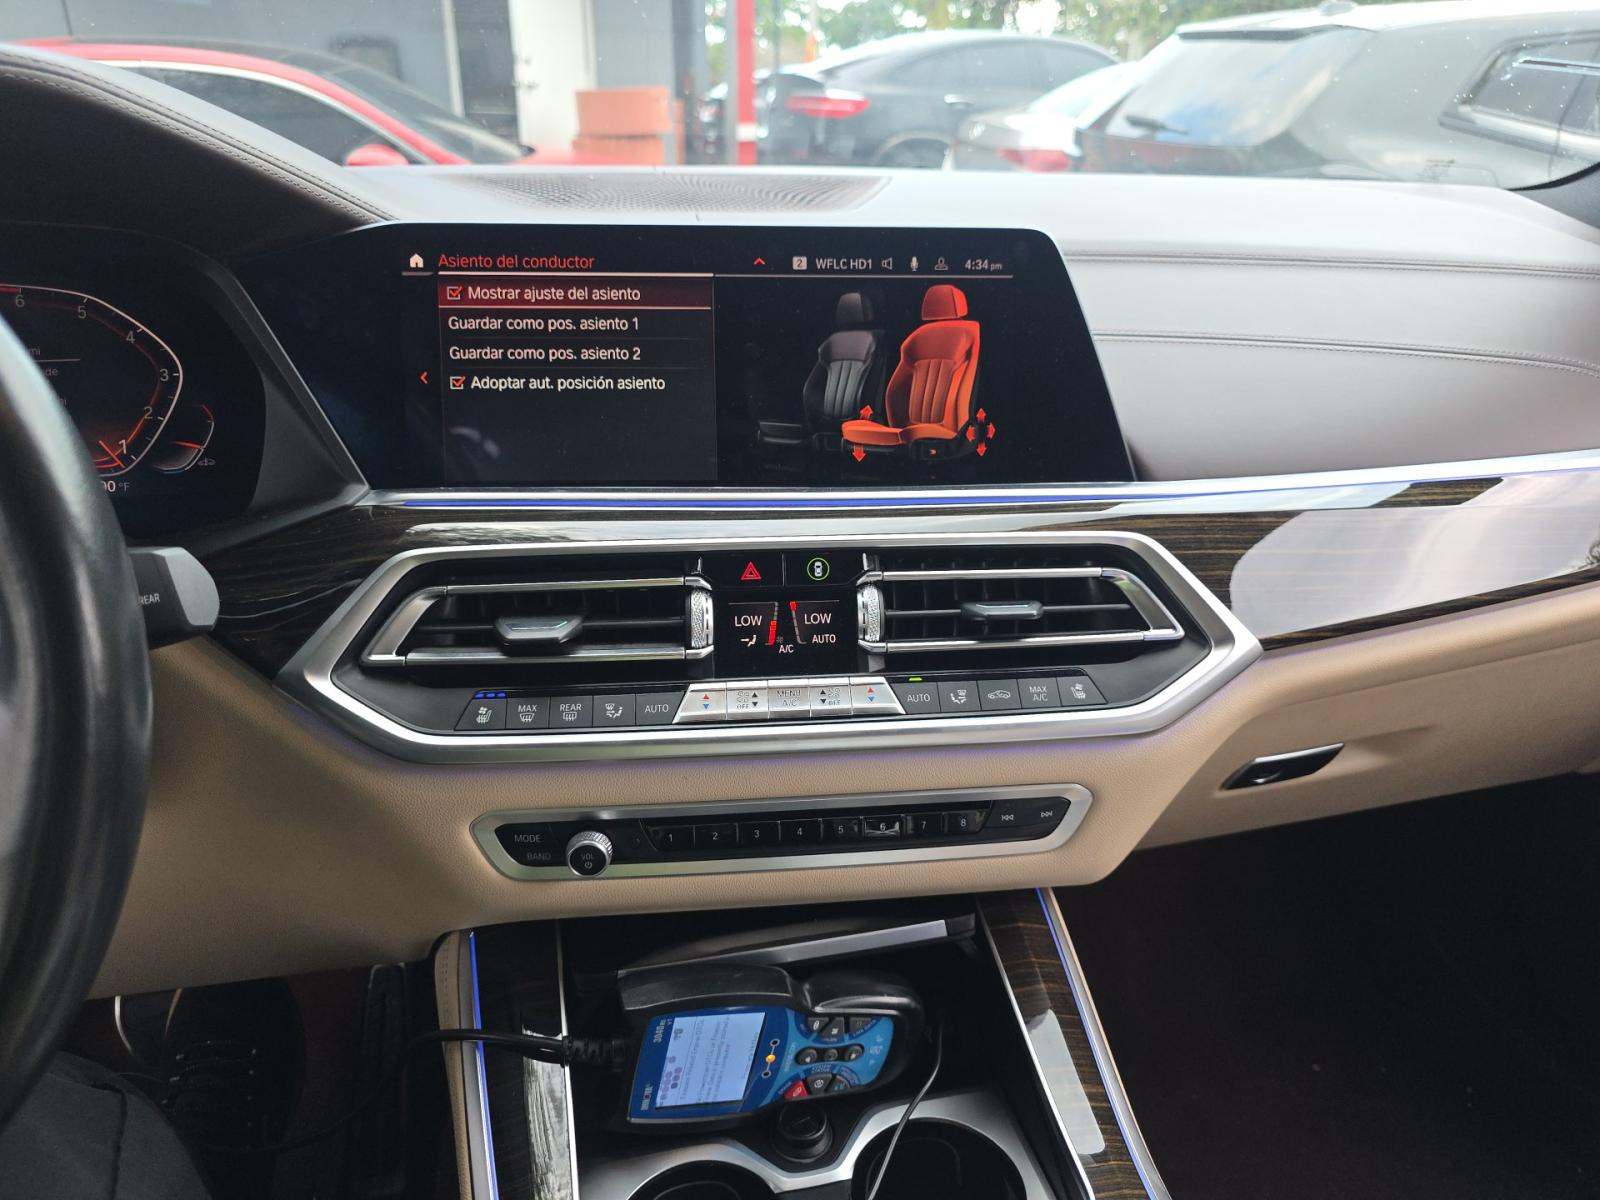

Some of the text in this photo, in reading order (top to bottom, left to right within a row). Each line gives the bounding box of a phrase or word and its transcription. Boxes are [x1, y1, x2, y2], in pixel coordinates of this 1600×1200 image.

[438, 254, 595, 269] Asiento del conductor
[815, 258, 872, 270] WFLC HD1
[965, 258, 1002, 271] 4:34 pm
[468, 286, 641, 302] Mostrar ajuste del asiento
[15, 294, 25, 307] 6
[78, 305, 87, 318] 5
[448, 316, 639, 332] Guardar como pos. asiento 1
[126, 331, 136, 343] 4
[449, 346, 641, 363] Guardar como pos. asiento 2
[160, 368, 169, 382] 3
[471, 376, 665, 392] Adoptar aut. posición asiento
[144, 406, 153, 419] 2
[118, 439, 127, 453] 1
[734, 615, 762, 626] LOW
[804, 613, 832, 625] LOW
[812, 634, 836, 644] AUTO
[778, 644, 794, 653] A/C
[1029, 686, 1048, 694] MAX
[907, 694, 931, 703] AUTO
[1032, 693, 1048, 702] A/C
[560, 703, 581, 711] REAR
[644, 705, 669, 713] AUTO
[514, 834, 541, 843] MODE
